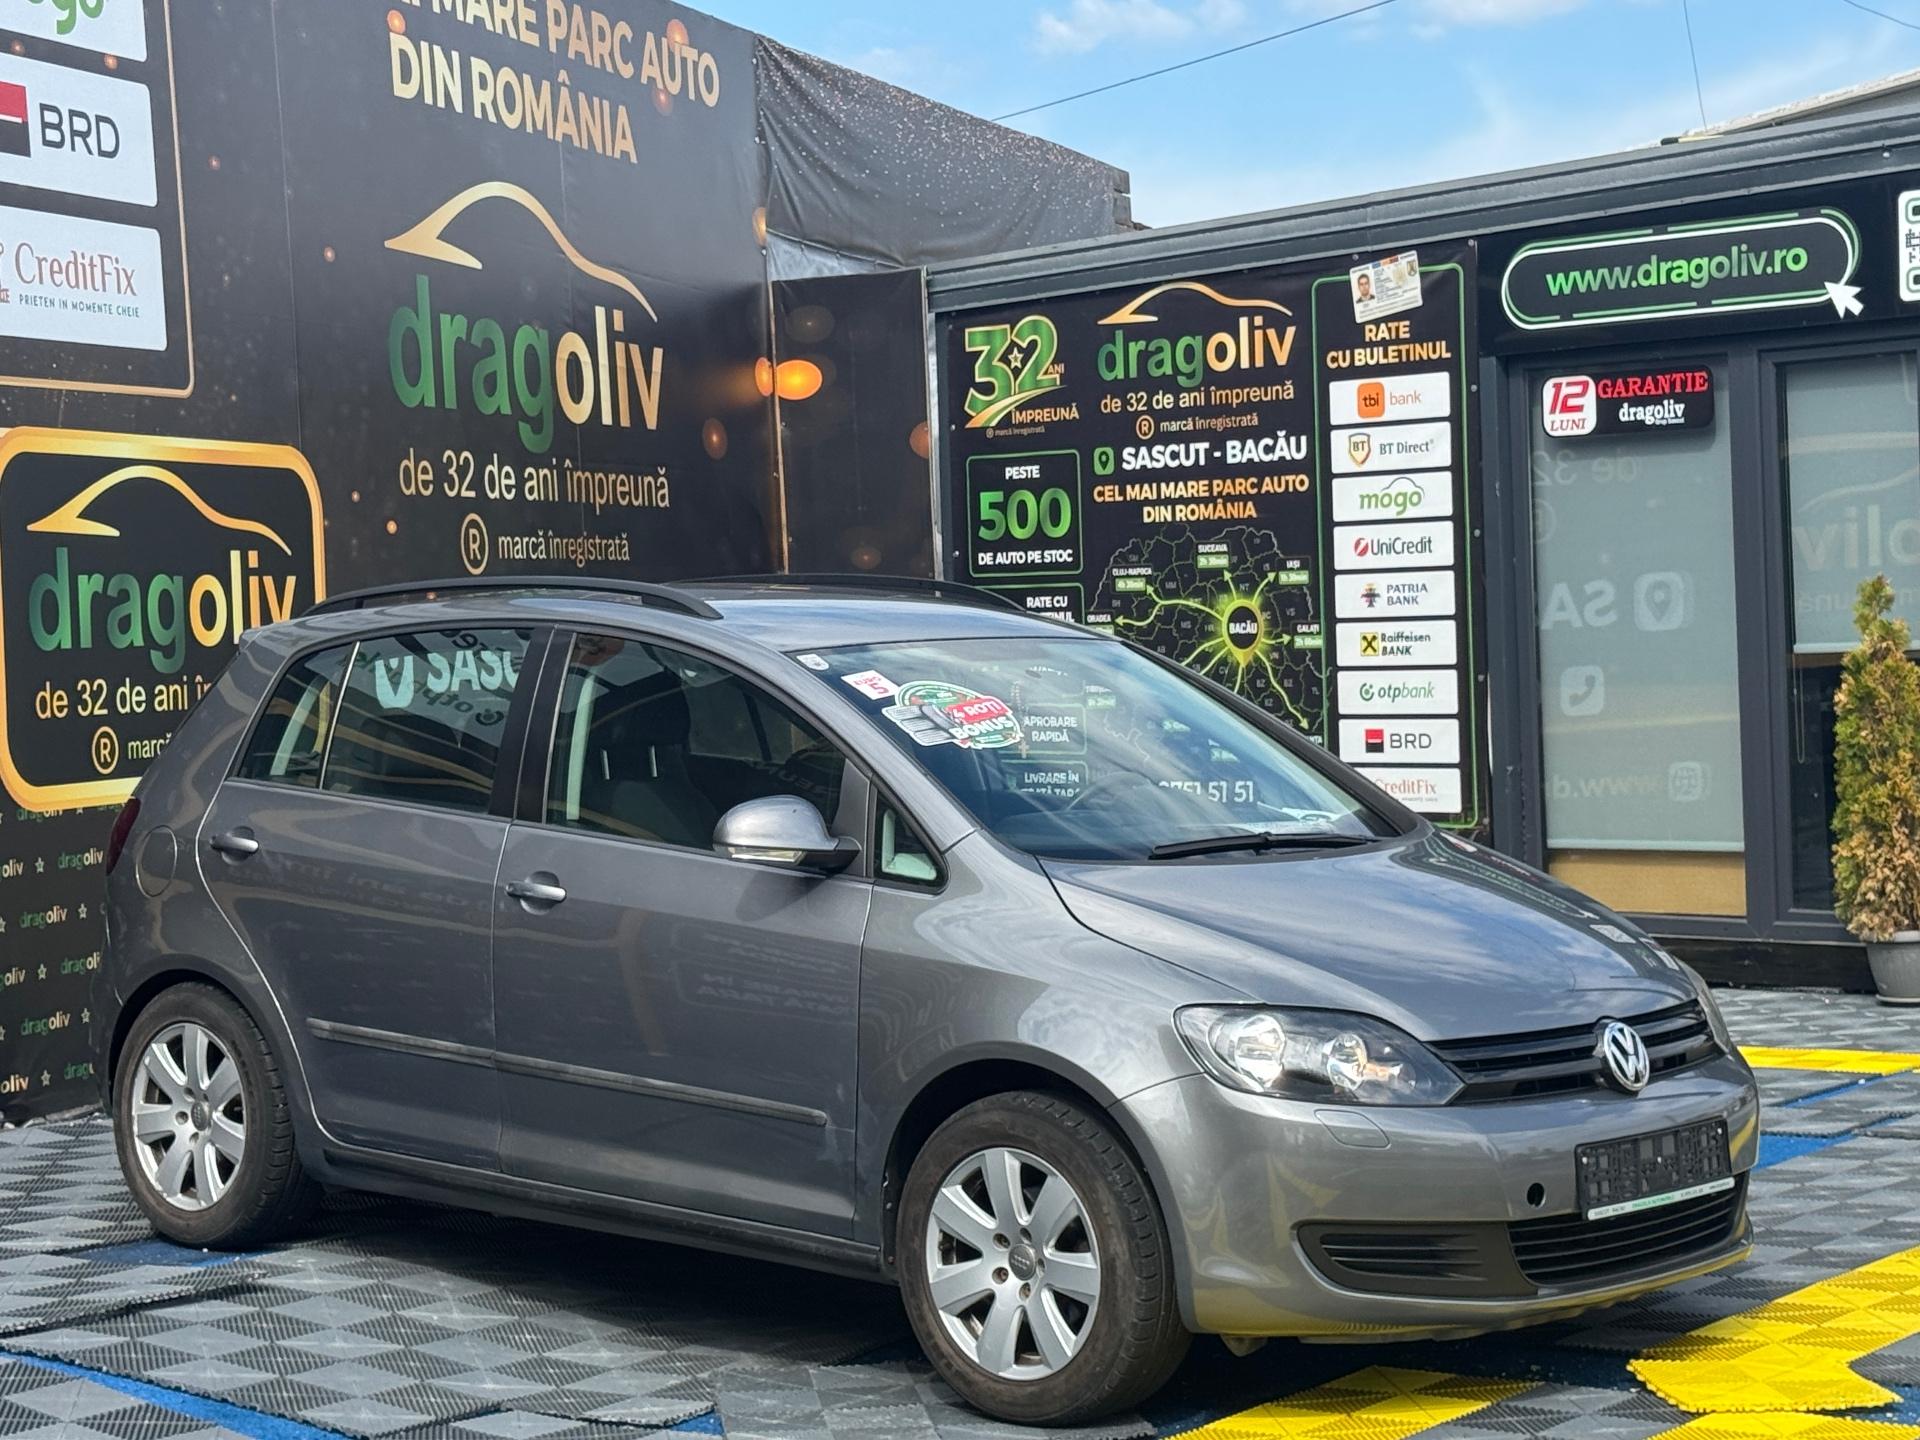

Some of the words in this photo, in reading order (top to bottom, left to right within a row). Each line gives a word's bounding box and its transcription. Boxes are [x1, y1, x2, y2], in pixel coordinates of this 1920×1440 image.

[548, 0, 634, 79] PARC
[641, 31, 720, 108] AUTO
[389, 31, 463, 113] DIN
[470, 56, 638, 164] ROMÂNIA
[39, 103, 120, 158] BRD
[15, 242, 137, 296] CreditFix
[1546, 243, 1808, 297] www.dragoliv.ro
[19, 293, 56, 308] PRIETEN
[59, 299, 68, 310] IN
[72, 301, 113, 315] MOMENTE
[116, 305, 140, 318] CHEIE
[1365, 321, 1411, 342] RATE
[388, 274, 664, 453] dragoliv
[1097, 315, 1296, 388] dragoliv
[1326, 350, 1351, 369] CU
[1354, 341, 1452, 367] BULETINUL
[964, 315, 1058, 418] 32
[1047, 363, 1065, 375] ANI
[1101, 394, 1121, 413] de
[1127, 391, 1147, 412] 32
[1152, 390, 1174, 410] de
[1179, 387, 1205, 408] ani
[1210, 380, 1294, 408] împreună
[1598, 371, 1709, 399] GARANTIE
[1362, 392, 1379, 408] tbi
[1390, 390, 1422, 406] bank
[1549, 381, 1589, 415] 12
[1160, 417, 1194, 432] marcă
[1195, 412, 1259, 432] înregistrată
[1619, 399, 1685, 425] dragoliv
[1550, 418, 1586, 431] LUNI
[1121, 442, 1209, 470] SASCUT
[1226, 430, 1308, 464] BACĂU
[1379, 443, 1395, 455] BT
[400, 448, 434, 496] de
[443, 450, 476, 498] 32
[484, 453, 516, 500] de
[524, 458, 559, 501] ani
[565, 460, 670, 516] împreună
[1005, 465, 1041, 480] PESTE
[1093, 485, 1123, 503] CEL
[1126, 482, 1157, 501] MAI
[1160, 480, 1210, 499] MARE
[1213, 477, 1259, 496] PARC
[1261, 474, 1309, 493] AUTO
[978, 487, 1072, 541] 500
[1143, 506, 1173, 523] DIN
[1176, 498, 1257, 521] ROMÂNIA
[1359, 490, 1422, 516] mogo
[498, 532, 547, 560] marcă
[549, 530, 630, 567] înregistrată
[978, 553, 994, 565] DE
[995, 552, 1026, 565] AUTO
[1028, 551, 1043, 563] PE
[1044, 550, 1074, 563] STOC
[1370, 536, 1432, 556] UniCredit
[1386, 583, 1428, 594] PATRIA
[29, 547, 296, 674] dragoliv
[1026, 596, 1052, 608] RATE
[1053, 595, 1068, 607] CU
[1387, 596, 1419, 606] BANK
[1229, 619, 1257, 634] BACĂU
[1381, 632, 1431, 643] Raiffeisen
[1381, 646, 1413, 656] BANK
[36, 682, 68, 720] de
[77, 678, 108, 717] 32
[116, 677, 147, 714] de
[154, 675, 188, 712] ani
[868, 683, 889, 695] 5
[1378, 682, 1435, 703] otpbank
[949, 716, 1014, 740] BONUS
[1023, 716, 1078, 727] APROBARE
[127, 732, 172, 759] marc
[1032, 729, 1069, 742] RAPIDĂ
[1390, 733, 1432, 749] BRD
[1024, 771, 1067, 784] LIVRARE
[1208, 781, 1227, 803] 51
[1233, 781, 1254, 803] 51
[58, 847, 104, 870] dragoliv
[20, 905, 68, 929] dragoliv
[21, 1010, 71, 1036] dragoliv
